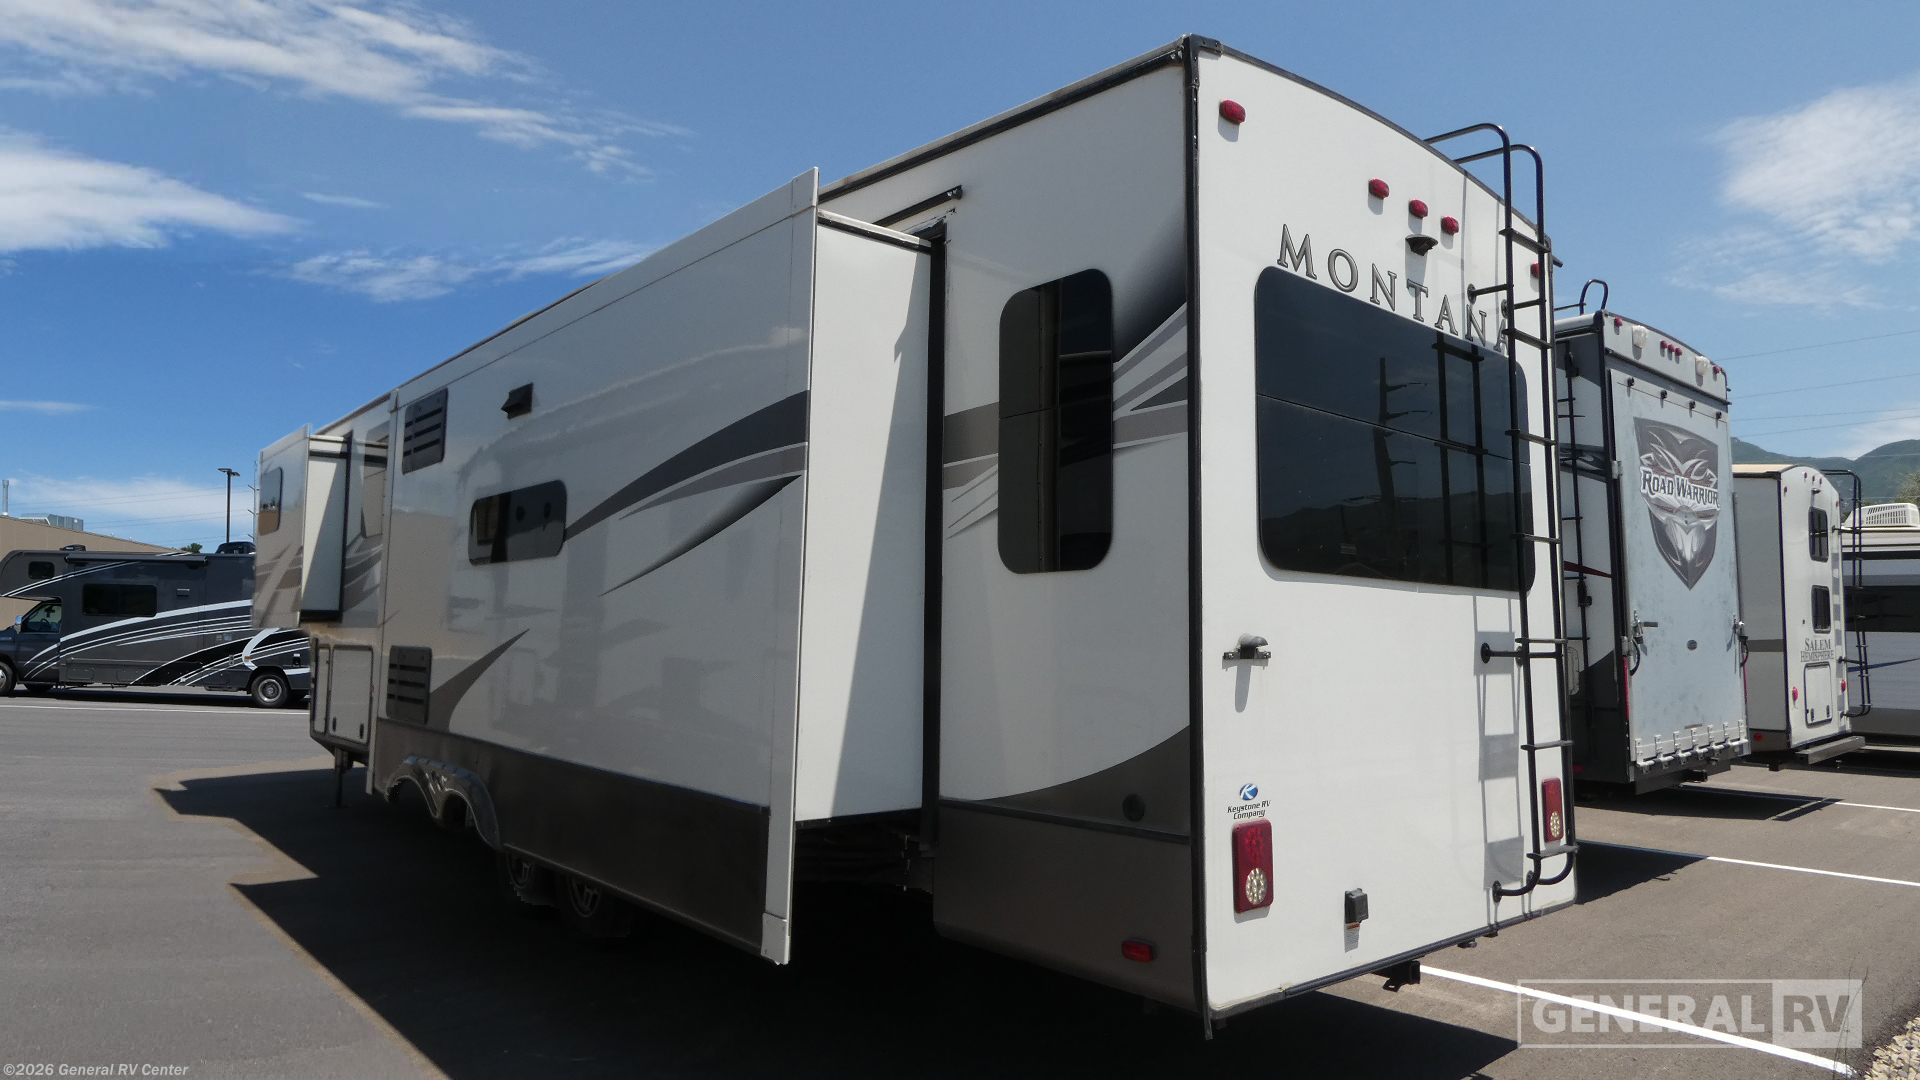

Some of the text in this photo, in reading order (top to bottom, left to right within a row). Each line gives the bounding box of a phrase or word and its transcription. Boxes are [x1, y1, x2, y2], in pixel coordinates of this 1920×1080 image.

[1277, 223, 1509, 355] MONTANA
[1642, 470, 1719, 507] ROAD WARRIOR
[1804, 638, 1831, 651] SALEM
[1800, 650, 1834, 662] HEMISPHERE
[1227, 799, 1271, 813] Keystone RV
[1233, 809, 1266, 820] Company
